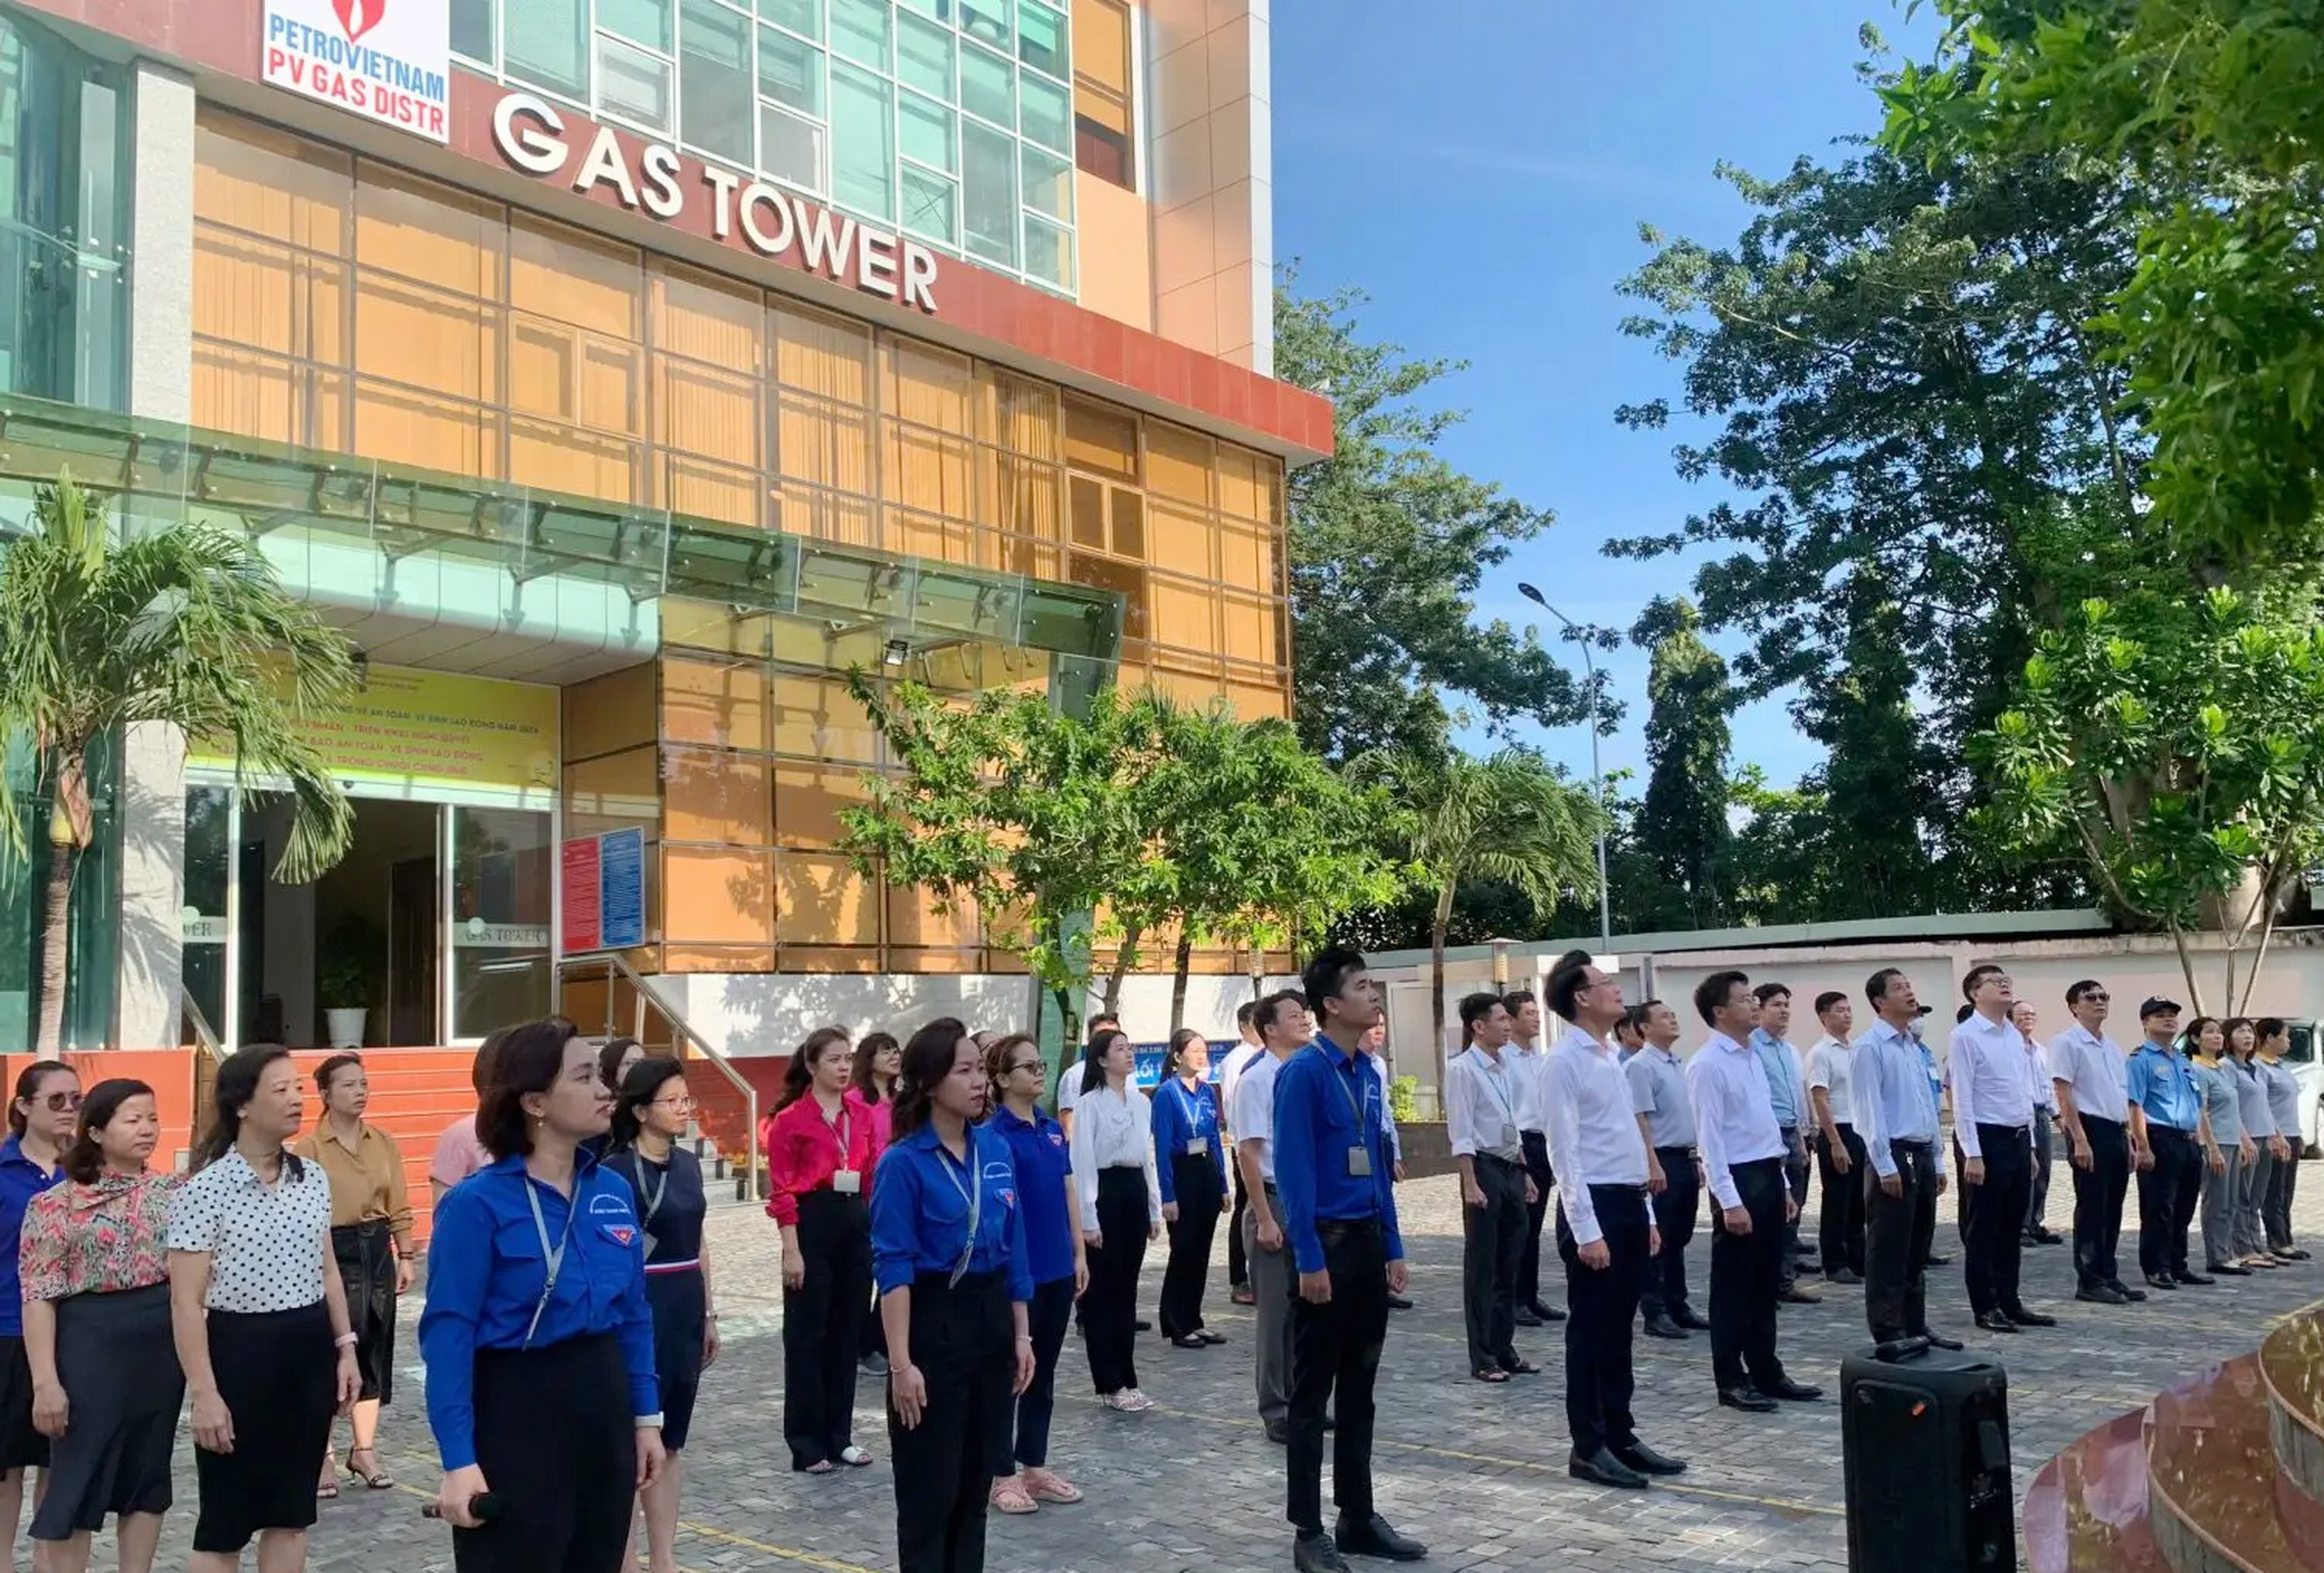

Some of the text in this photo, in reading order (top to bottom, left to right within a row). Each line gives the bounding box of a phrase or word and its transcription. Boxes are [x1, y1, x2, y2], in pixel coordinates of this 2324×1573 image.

[269, 47, 444, 136] PV GAS DISTR
[270, 12, 445, 102] PETROVIETNAM
[493, 93, 937, 313] GAS TOWER
